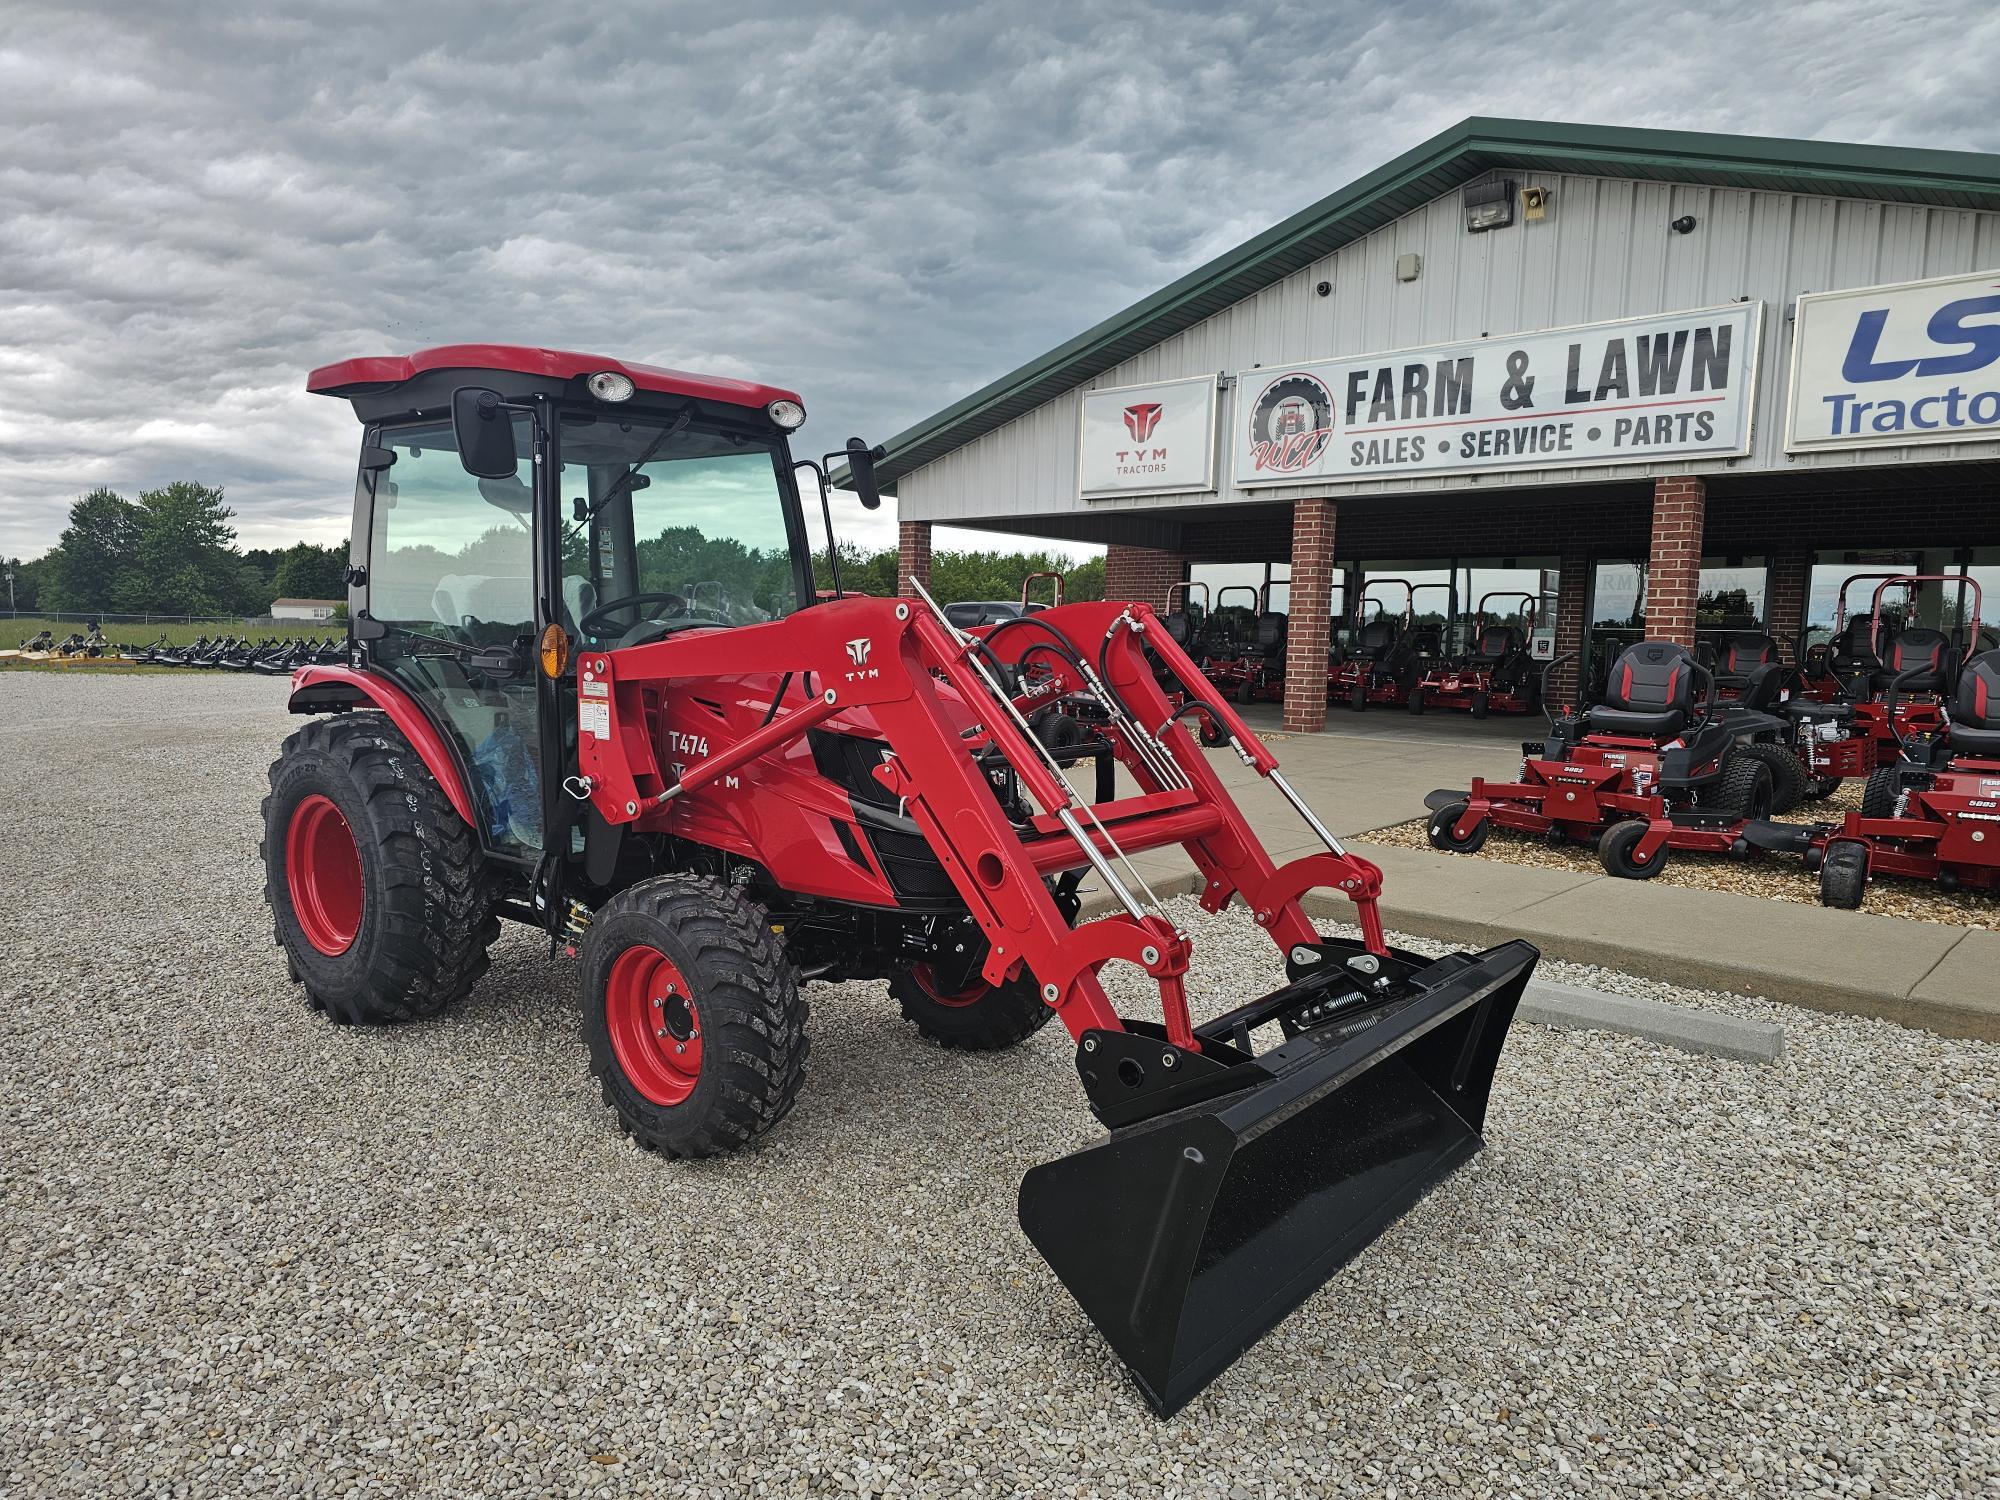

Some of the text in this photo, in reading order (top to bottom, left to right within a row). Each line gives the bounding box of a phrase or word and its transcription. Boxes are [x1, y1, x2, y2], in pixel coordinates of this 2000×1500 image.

[1842, 295, 2000, 383] LS
[1345, 324, 1733, 425] FARM & LAWN
[1823, 386, 2000, 435] Tracto
[1115, 448, 1167, 462] TYM
[1350, 411, 1715, 466] SALES SERVICE PARTS
[1116, 463, 1167, 474] TRACTORS
[845, 668, 879, 682] TYM
[669, 731, 709, 757] T474
